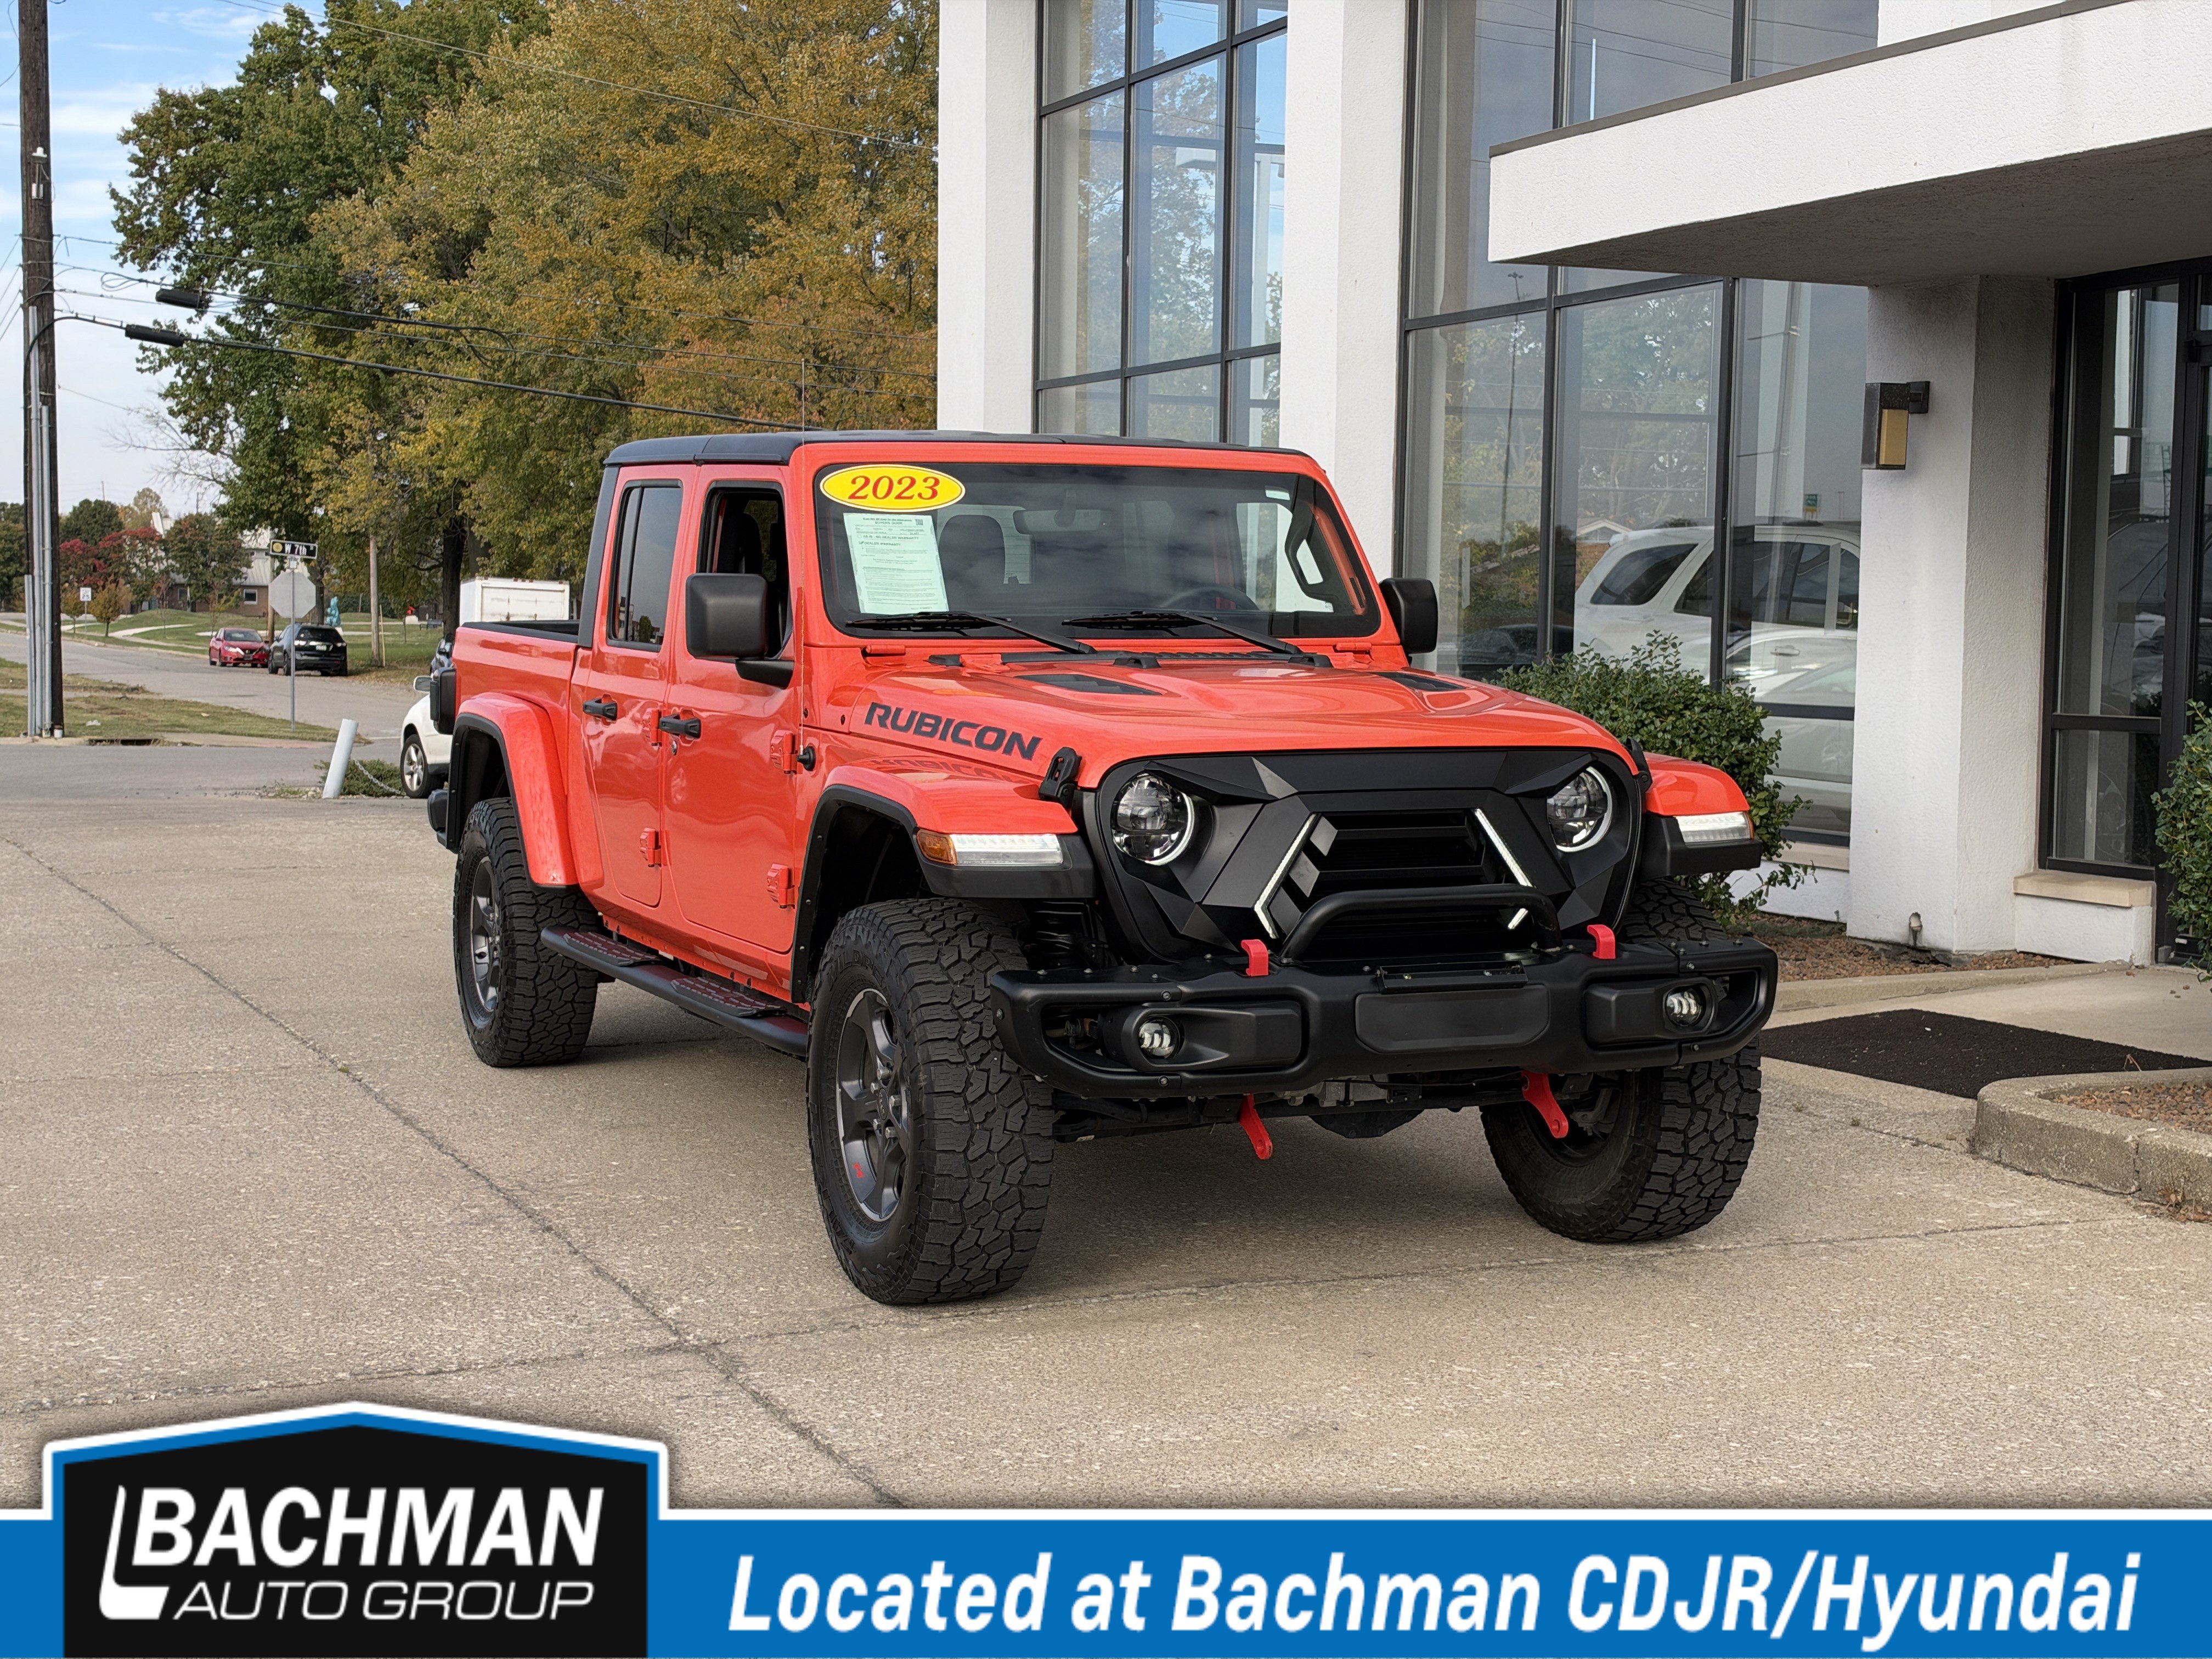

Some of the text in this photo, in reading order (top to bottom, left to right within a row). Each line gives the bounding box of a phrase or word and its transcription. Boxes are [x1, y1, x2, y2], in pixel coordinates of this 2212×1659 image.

[848, 475, 941, 500] 2023
[285, 543, 291, 555] W
[294, 544, 307, 556] 7th
[865, 702, 1042, 760] RUBICON
